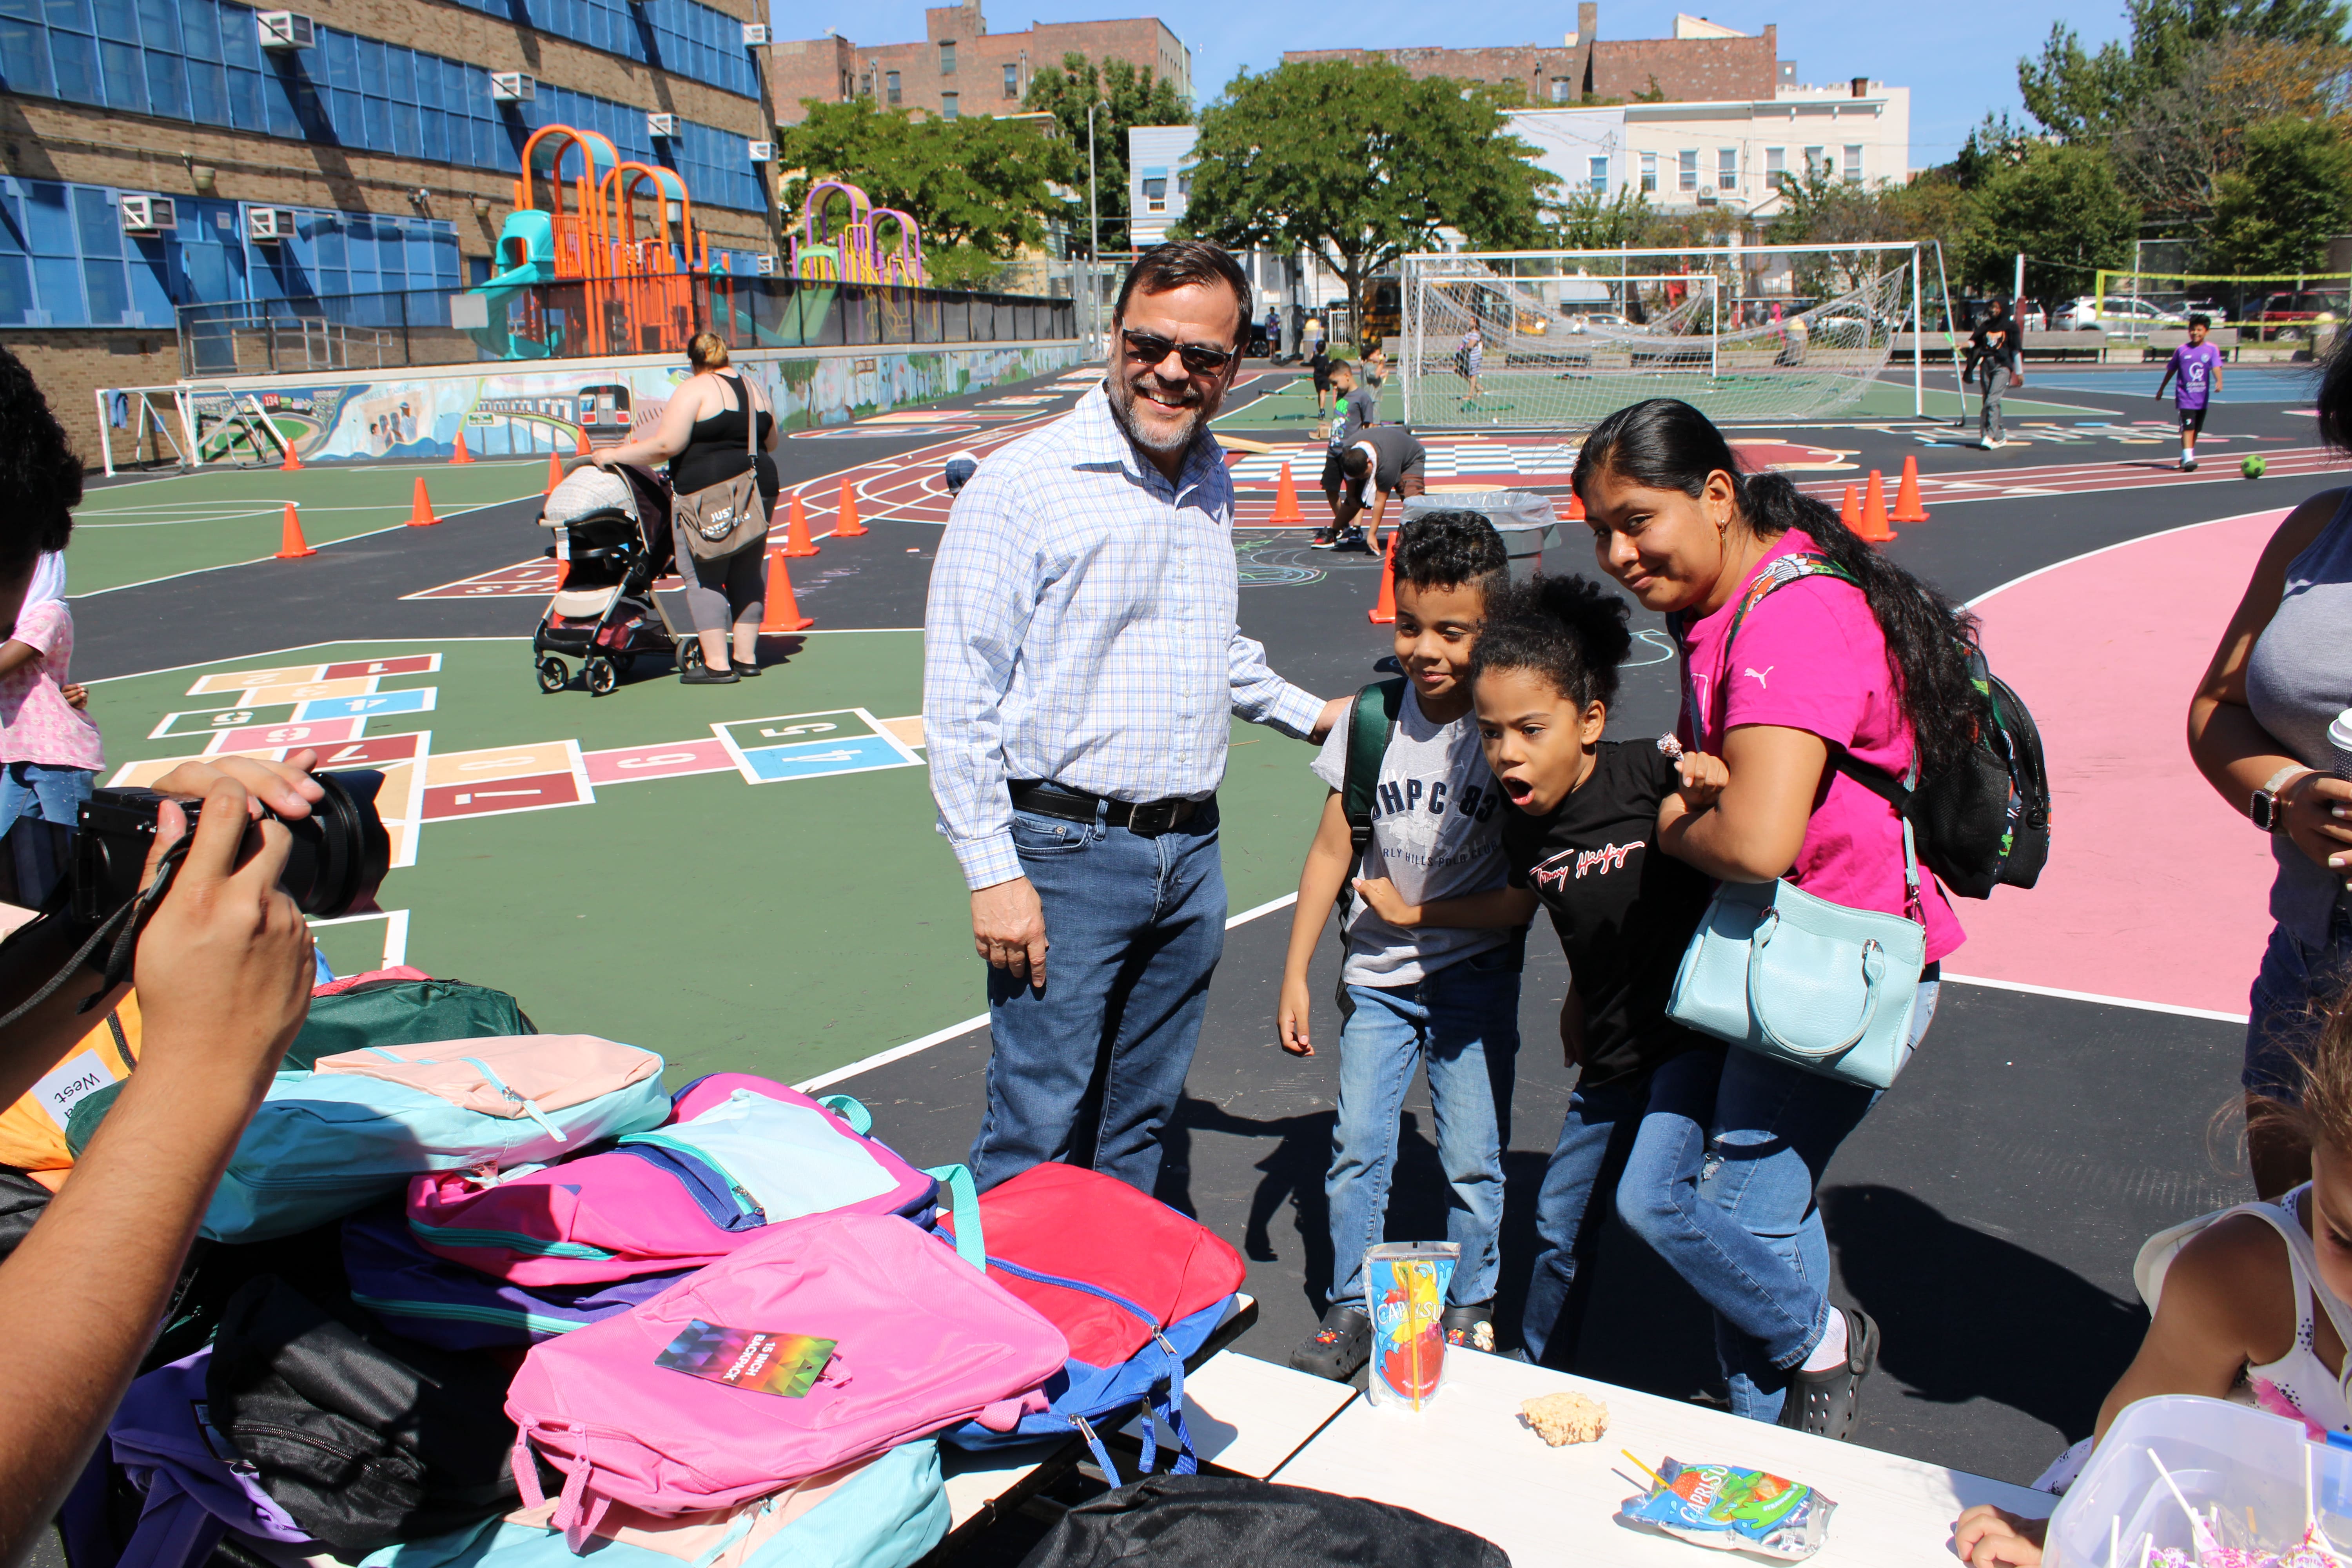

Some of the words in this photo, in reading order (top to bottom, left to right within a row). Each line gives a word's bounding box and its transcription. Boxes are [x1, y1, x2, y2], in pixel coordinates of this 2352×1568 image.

[265, 396, 279, 407] 134
[367, 662, 389, 673] 1
[241, 673, 281, 685] 2
[291, 685, 329, 697] 3
[345, 699, 388, 711] 4
[211, 711, 254, 726] 5
[265, 727, 311, 742] 6
[760, 722, 838, 738] 5
[327, 744, 368, 763] 7
[782, 749, 864, 765] 4
[458, 755, 536, 771] 8
[1459, 785, 1498, 823] 83
[1383, 848, 1402, 858] RLY
[1405, 852, 1433, 866] HILLS
[1438, 854, 1466, 867] POLO
[1471, 840, 1497, 860] CLUB
[1529, 849, 1574, 892] Tommy
[54, 1073, 100, 1103] West
[762, 1342, 776, 1352] 15
[723, 1334, 766, 1381] BACKPACK
[745, 1354, 769, 1376] INCH
[1402, 1380, 1414, 1389] FRUI
[1418, 1380, 1434, 1390] PUNCH
[1680, 1465, 1728, 1523] CAPRISU
